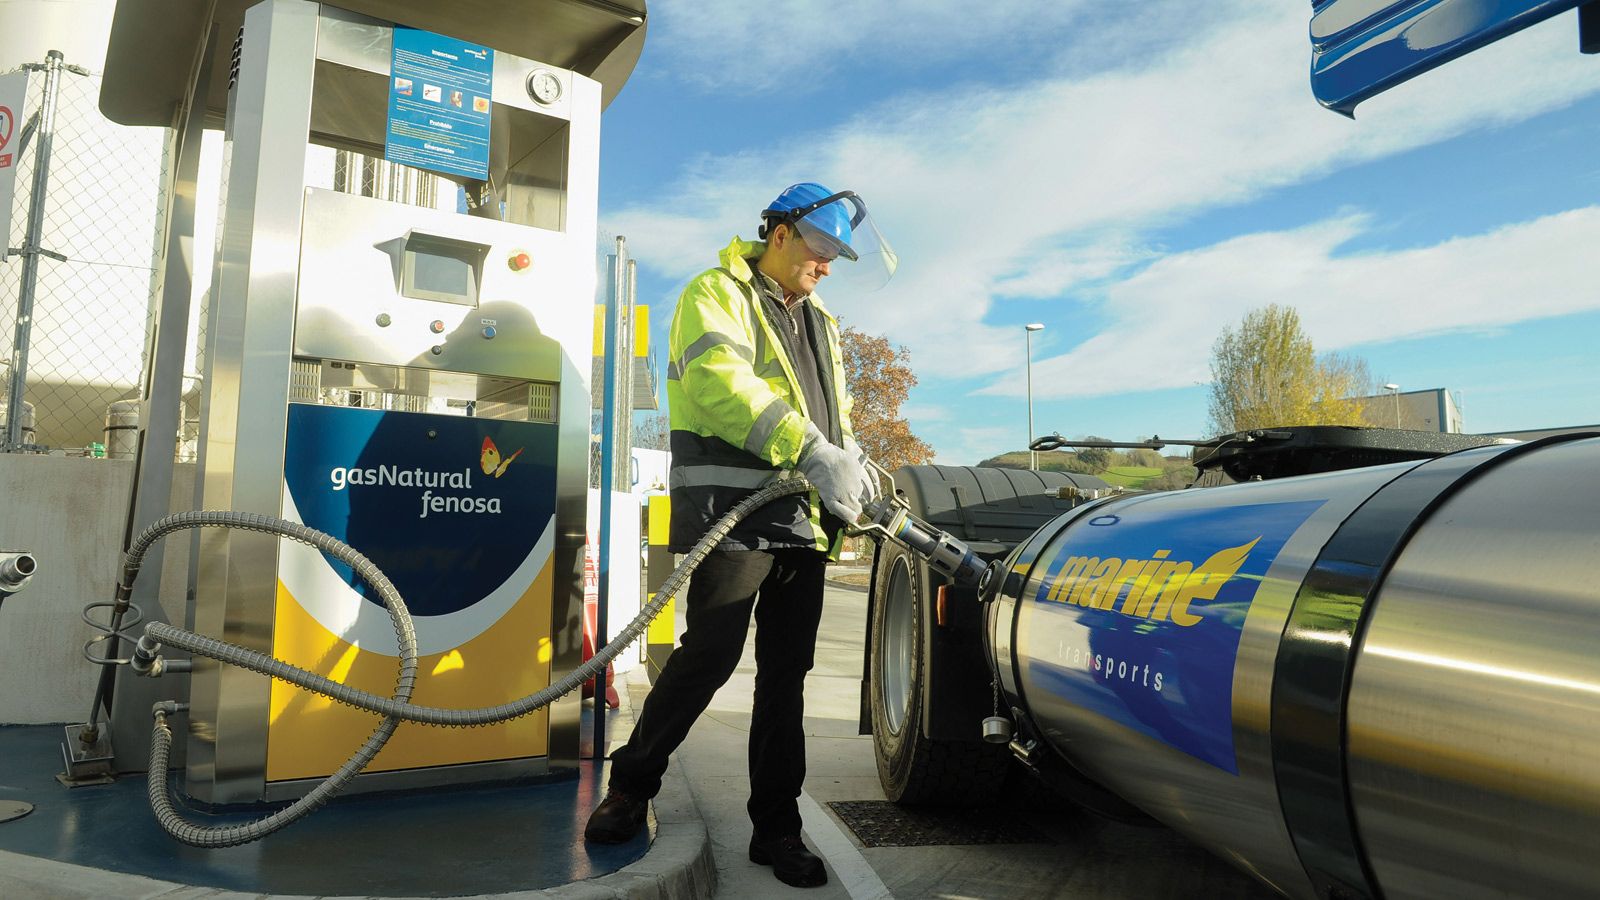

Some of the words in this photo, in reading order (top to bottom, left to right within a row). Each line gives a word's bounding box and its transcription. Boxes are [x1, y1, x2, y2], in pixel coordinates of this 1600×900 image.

[330, 465, 472, 491] gasNatural
[420, 490, 502, 518] fenosa
[1047, 537, 1260, 626] marine
[1058, 641, 1165, 692] transports
